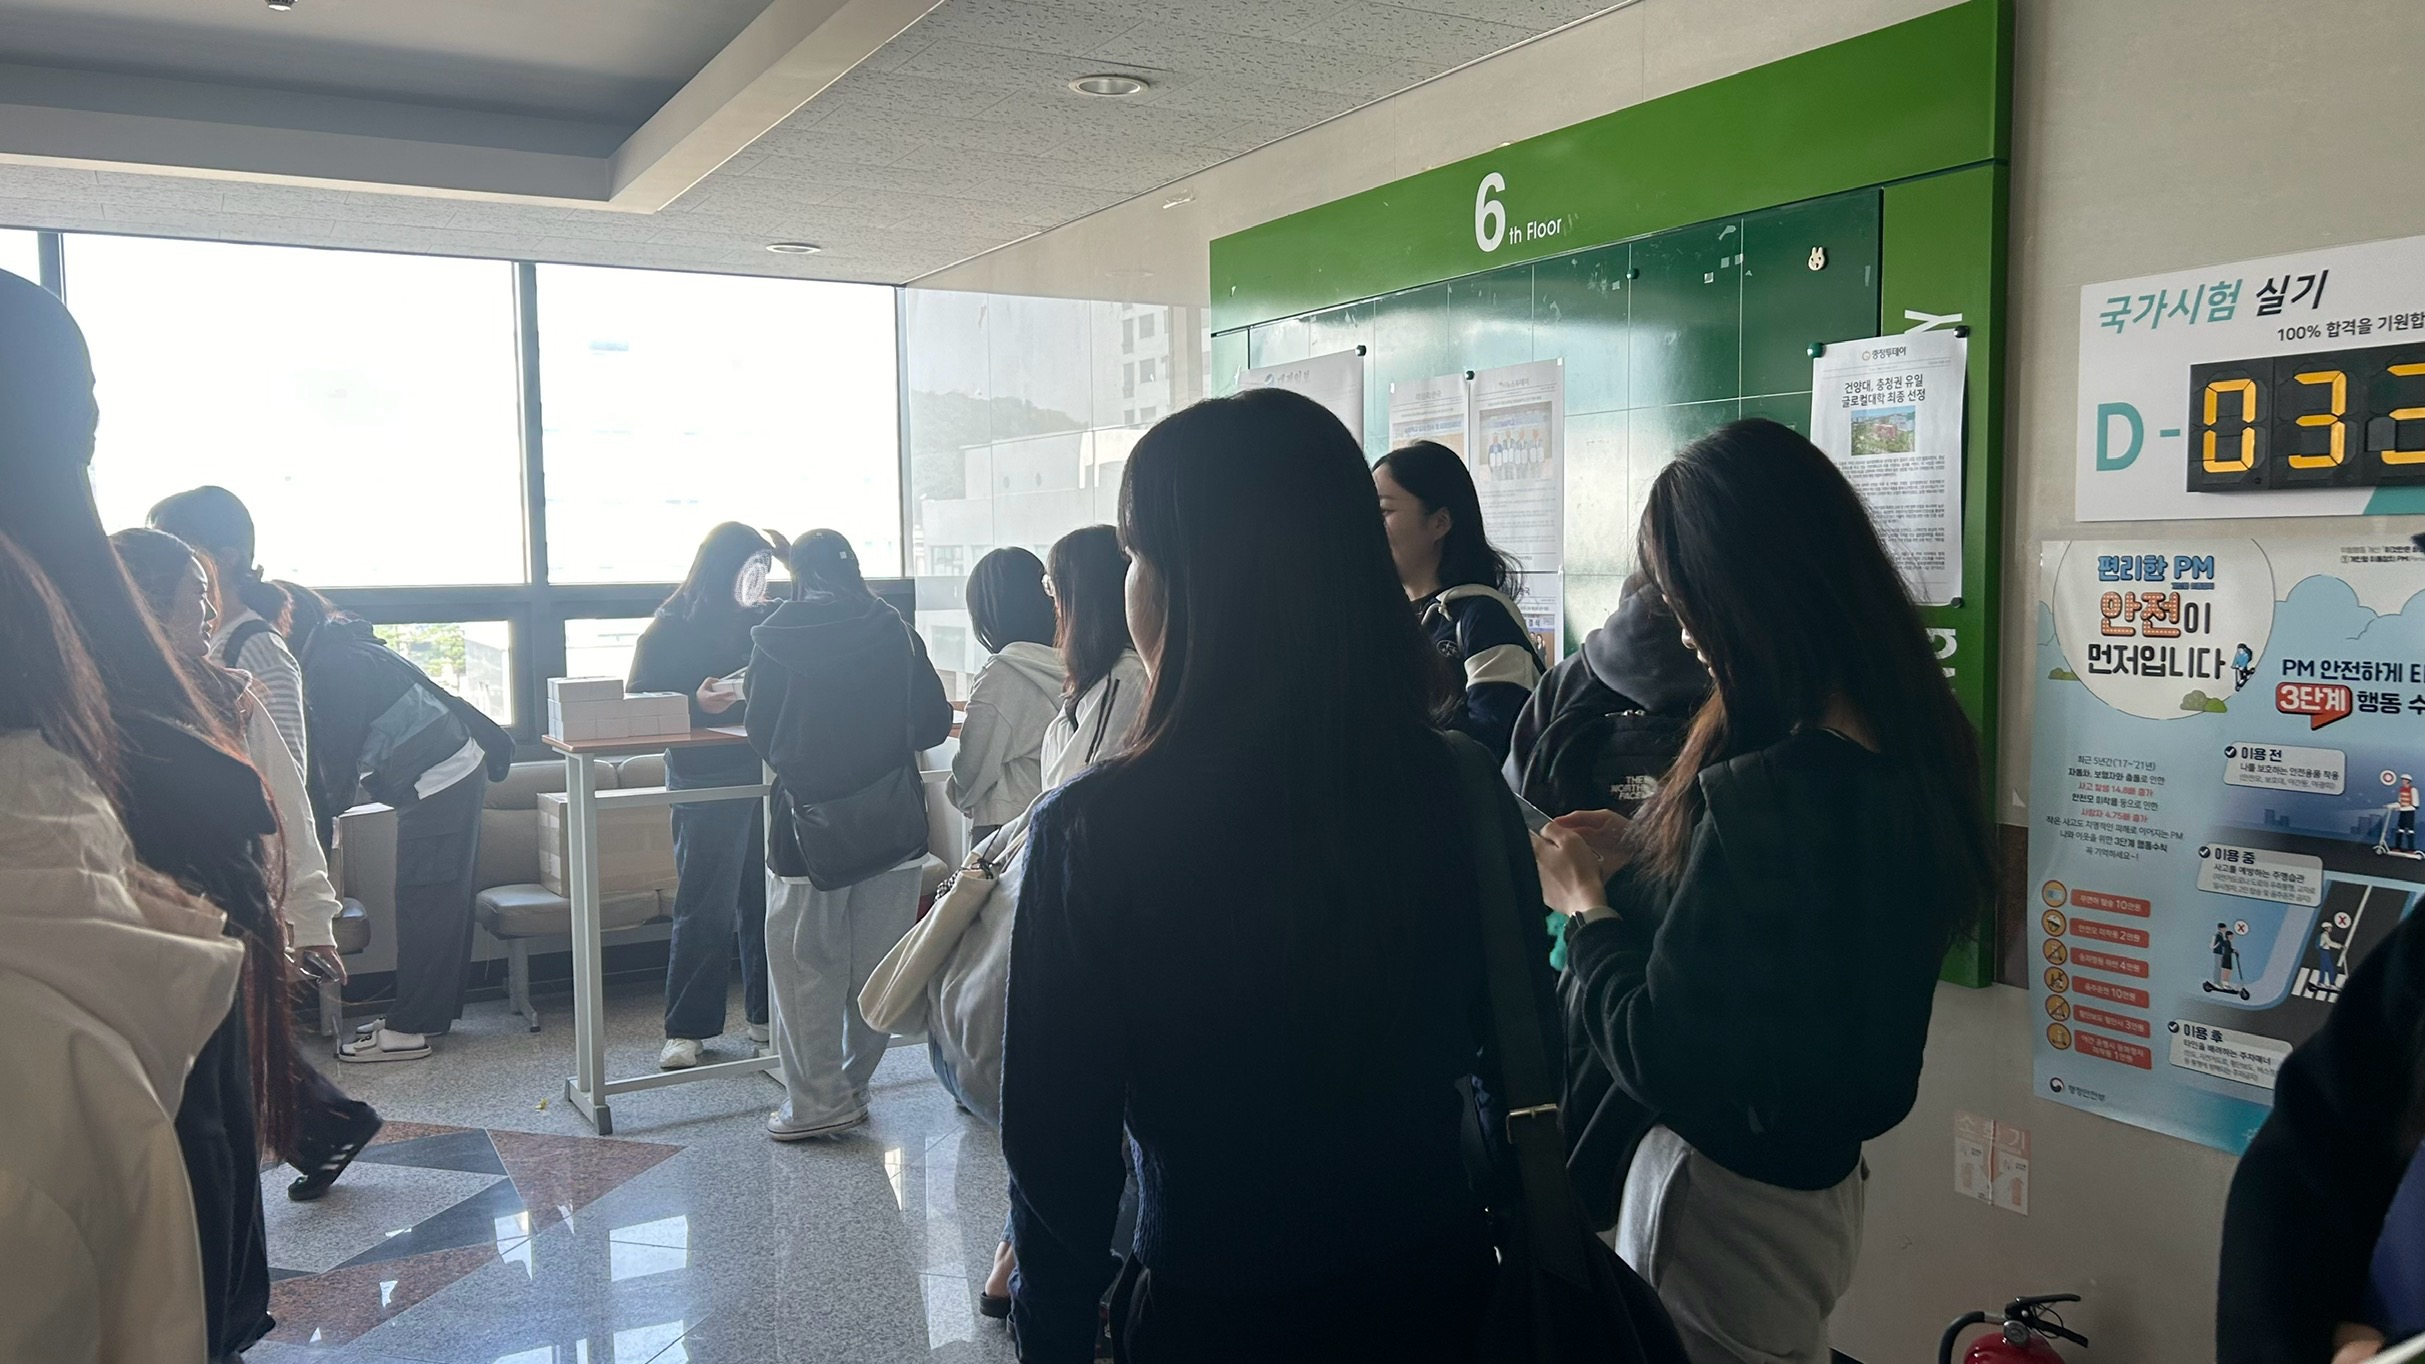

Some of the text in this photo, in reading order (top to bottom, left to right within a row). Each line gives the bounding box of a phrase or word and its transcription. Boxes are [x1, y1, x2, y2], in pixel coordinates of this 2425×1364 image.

[1474, 171, 1562, 253] 6 th Floor
[2098, 269, 2329, 334] 국가시험 실기
[2277, 311, 2425, 341] 100% 합격을 기원합
[1844, 373, 1924, 394] 건양대, 충청권 유일
[1841, 388, 1926, 409] 글로컬대학 최종 선정
[2097, 554, 2214, 582] 편리한 PM
[2100, 591, 2211, 638] 안전이
[2087, 643, 2226, 680] 먼저입니다
[2282, 659, 2315, 677] PM
[2320, 659, 2402, 683] 안전하게
[2280, 684, 2345, 712] 3단계
[2357, 690, 2402, 714] 행동
[2077, 755, 2092, 765] 최근
[2241, 746, 2282, 762] 이용 전
[1625, 775, 1645, 784] THE
[2149, 775, 2166, 786] 인한
[2257, 764, 2288, 776] 보호하는
[2289, 767, 2322, 779] 안전용품
[2323, 770, 2339, 781] 착용
[1610, 784, 1643, 793] NORTH
[1618, 791, 1642, 800] FACE
[2079, 781, 2093, 791] 사고
[2072, 793, 2094, 804] 안전모
[2120, 798, 2142, 809] 등으로
[2143, 801, 2159, 812] 인한
[2063, 817, 2084, 827] 사고도
[2139, 826, 2169, 839] 이어지는
[2170, 830, 2184, 840] PM
[2060, 829, 2075, 839] 나와
[2076, 831, 2097, 842] 이웃을
[2114, 836, 2135, 848] 3단계
[2214, 847, 2255, 865] 이용 중
[2213, 863, 2305, 884] 사고를 예방하는 주행습관
[2116, 900, 2142, 912] 10만원
[2119, 930, 2141, 943] 2만원
[2119, 961, 2141, 973] 4만원
[2111, 987, 2136, 1001] 10만원
[2125, 1020, 2145, 1033] 3만원
[2183, 1023, 2223, 1043] 이용 후
